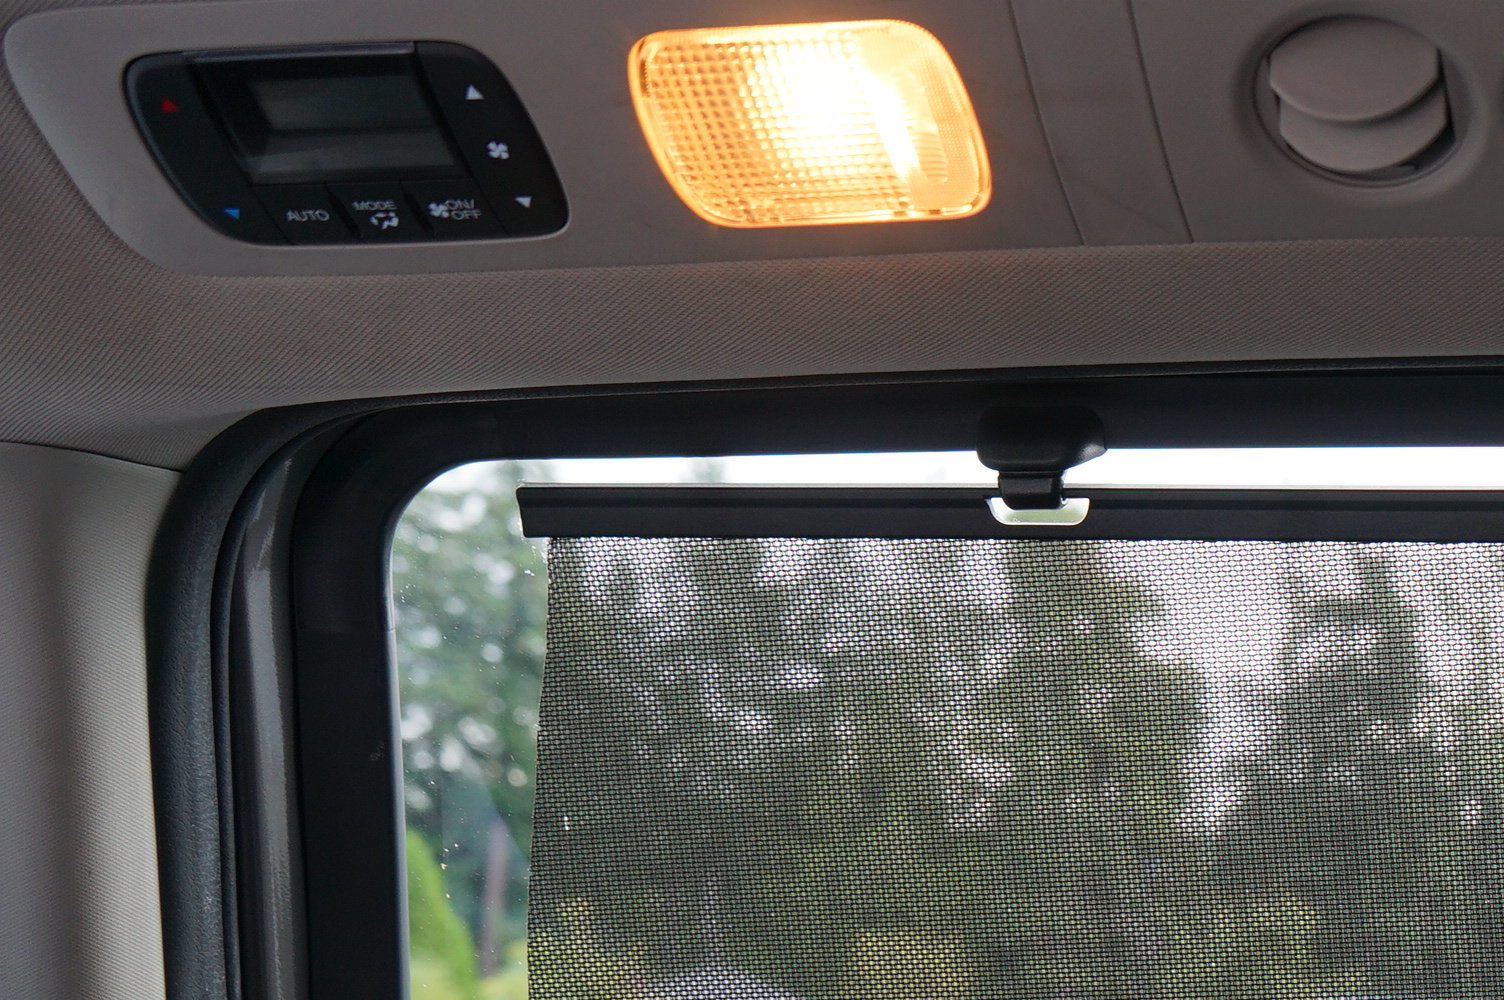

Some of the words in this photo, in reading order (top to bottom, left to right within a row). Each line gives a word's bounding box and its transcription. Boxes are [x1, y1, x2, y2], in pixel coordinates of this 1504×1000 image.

[352, 200, 397, 211] MODE
[286, 209, 330, 222] AUTO
[451, 209, 481, 220] OFF
